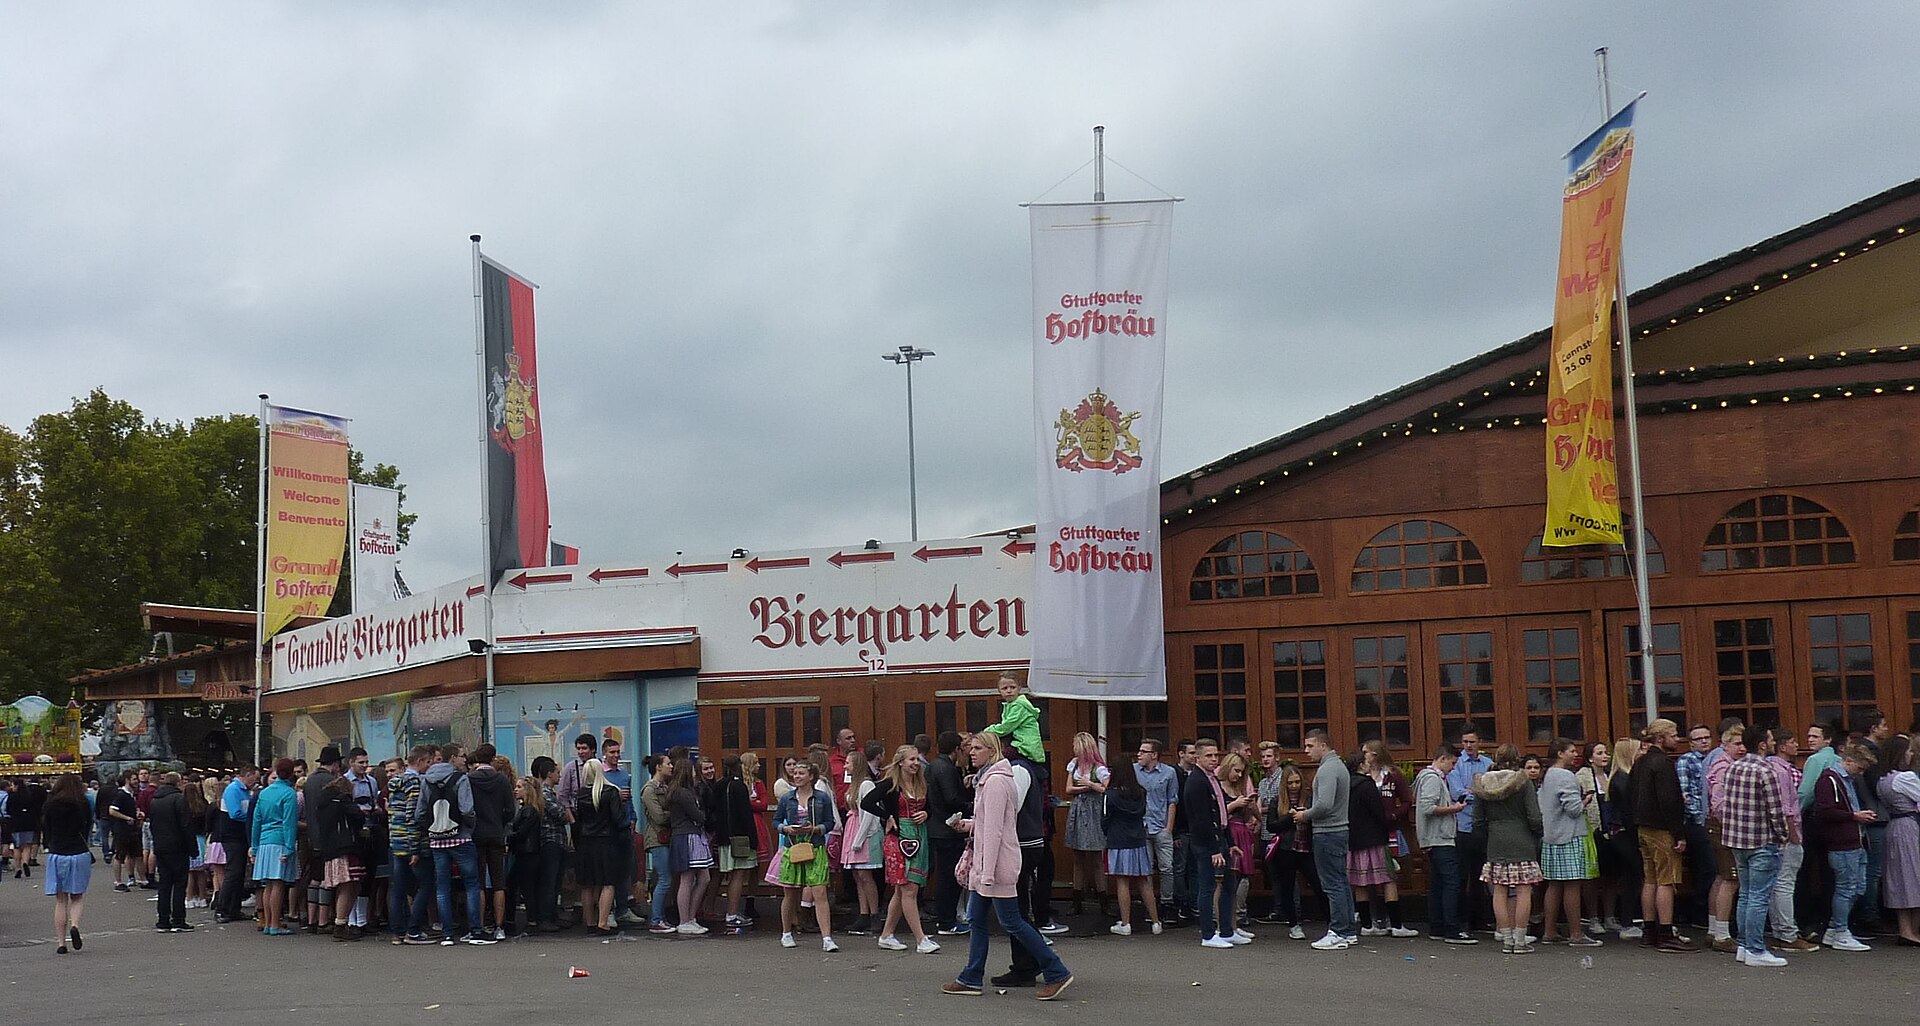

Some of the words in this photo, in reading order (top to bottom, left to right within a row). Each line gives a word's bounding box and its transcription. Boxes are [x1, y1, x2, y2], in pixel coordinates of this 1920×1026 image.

[1060, 290, 1143, 309] Stuttgarter
[1045, 309, 1156, 344] Hofbräu
[272, 466, 348, 485] Willkommen
[283, 488, 341, 506] Welcome
[278, 510, 346, 527] Benvenuto
[1059, 526, 1141, 542] Stuttgarter
[1048, 541, 1153, 575] Hofbräu
[749, 584, 1030, 663] Biergarten
[287, 621, 349, 675] Grandls
[352, 597, 466, 666] Biergarten
[869, 658, 885, 671] 12
